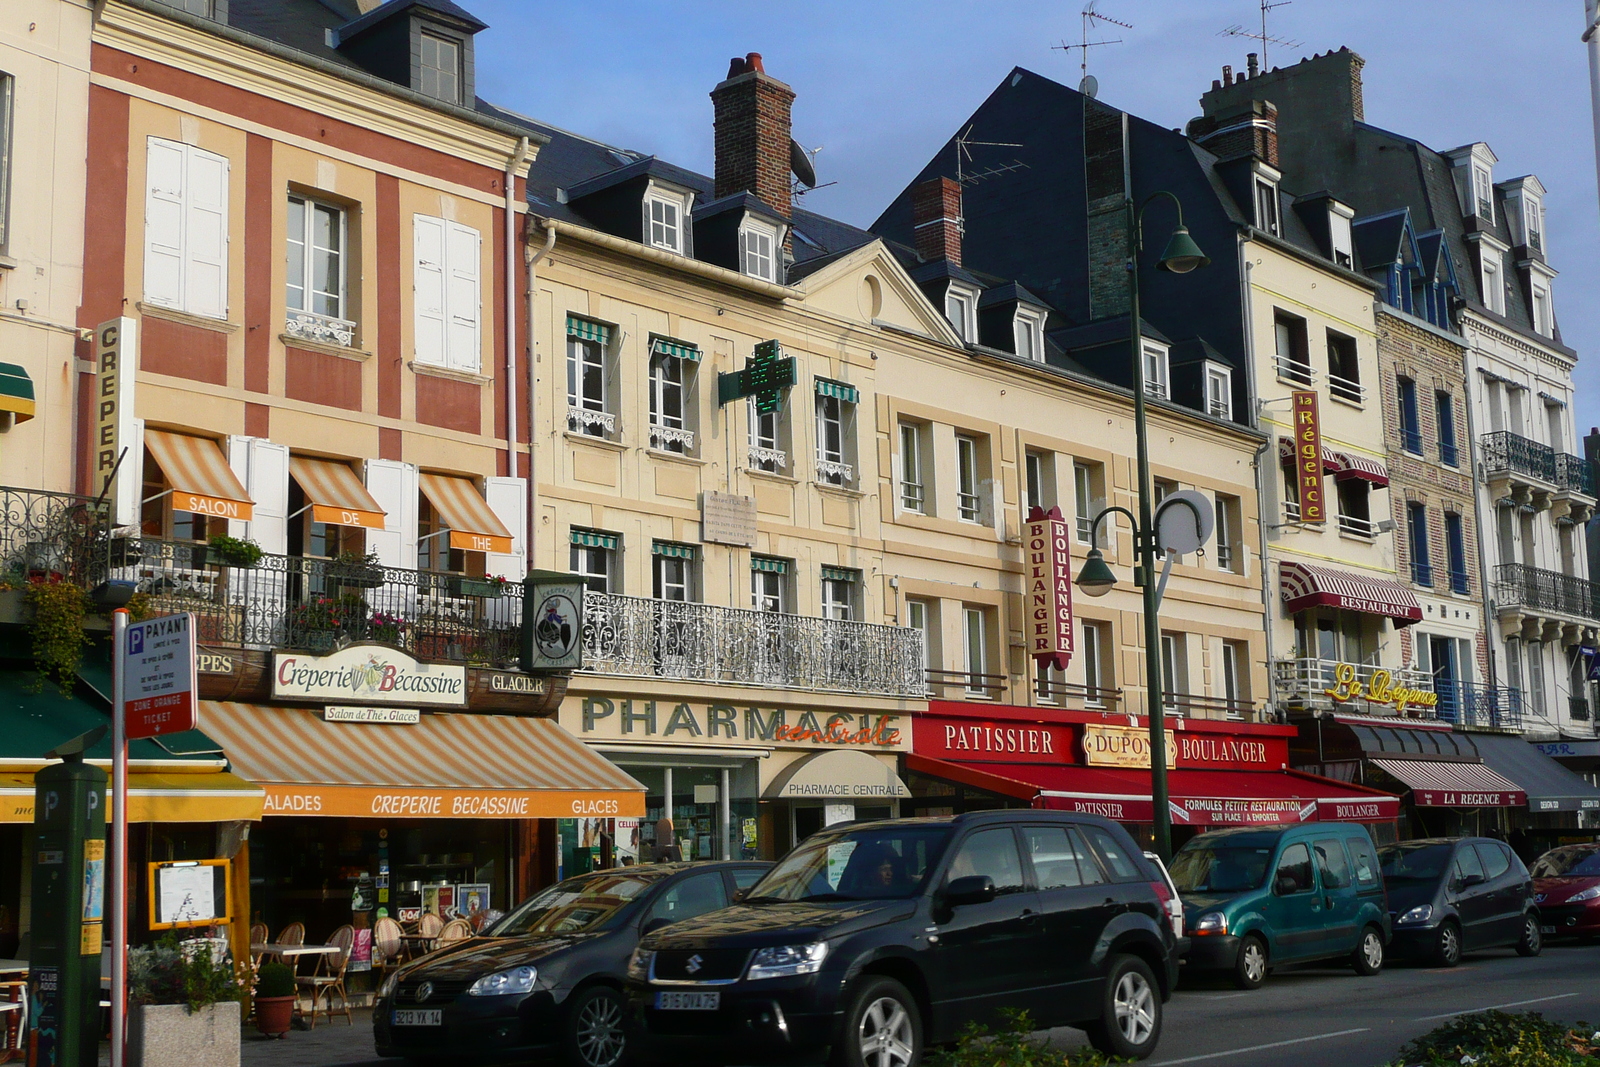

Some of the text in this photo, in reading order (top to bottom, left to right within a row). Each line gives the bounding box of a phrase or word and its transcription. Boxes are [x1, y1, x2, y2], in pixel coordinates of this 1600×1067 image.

[98, 326, 117, 497] CREPERI
[1298, 396, 1319, 518] la Régence
[189, 497, 238, 517] SALON
[342, 511, 359, 525] DE
[472, 536, 492, 550] THE
[1030, 524, 1049, 650] BOULANGER
[1055, 523, 1070, 650] BOULANGER
[1340, 596, 1411, 617] RESTAURANT
[146, 617, 187, 639] PAYANT
[278, 658, 462, 694] Crêperie Bécassine
[492, 674, 544, 693] GLACIER
[1364, 670, 1438, 712] Régence
[133, 694, 181, 711] ZONE ORANGE
[143, 711, 171, 725] TICKET
[327, 708, 418, 722] Salon de Thé Glaces
[585, 697, 901, 746] PHARMACIE
[776, 714, 902, 745] centrale
[945, 725, 1053, 754] PATISSIER
[1182, 738, 1267, 763] BOULANGER
[789, 783, 904, 796] PHARMACIE CENTRALE
[1444, 793, 1456, 804] LA
[1461, 793, 1500, 805] REGENCE
[371, 795, 442, 814] CREPERIE
[452, 796, 529, 815] BECASSINE
[571, 799, 618, 814] GLACES
[1074, 802, 1124, 818] PATISSIER
[1184, 799, 1301, 811] FORMULES PETITE RESTAURATION
[1336, 804, 1380, 817] BOULANGER
[1211, 812, 1223, 821] SUR
[1224, 812, 1241, 821] PLACE
[1252, 813, 1280, 821] EMPORTER
[40, 973, 58, 982] CLUB
[40, 982, 58, 991] ADOS
[416, 1011, 427, 1024] YX
[430, 1011, 440, 1024] 14
